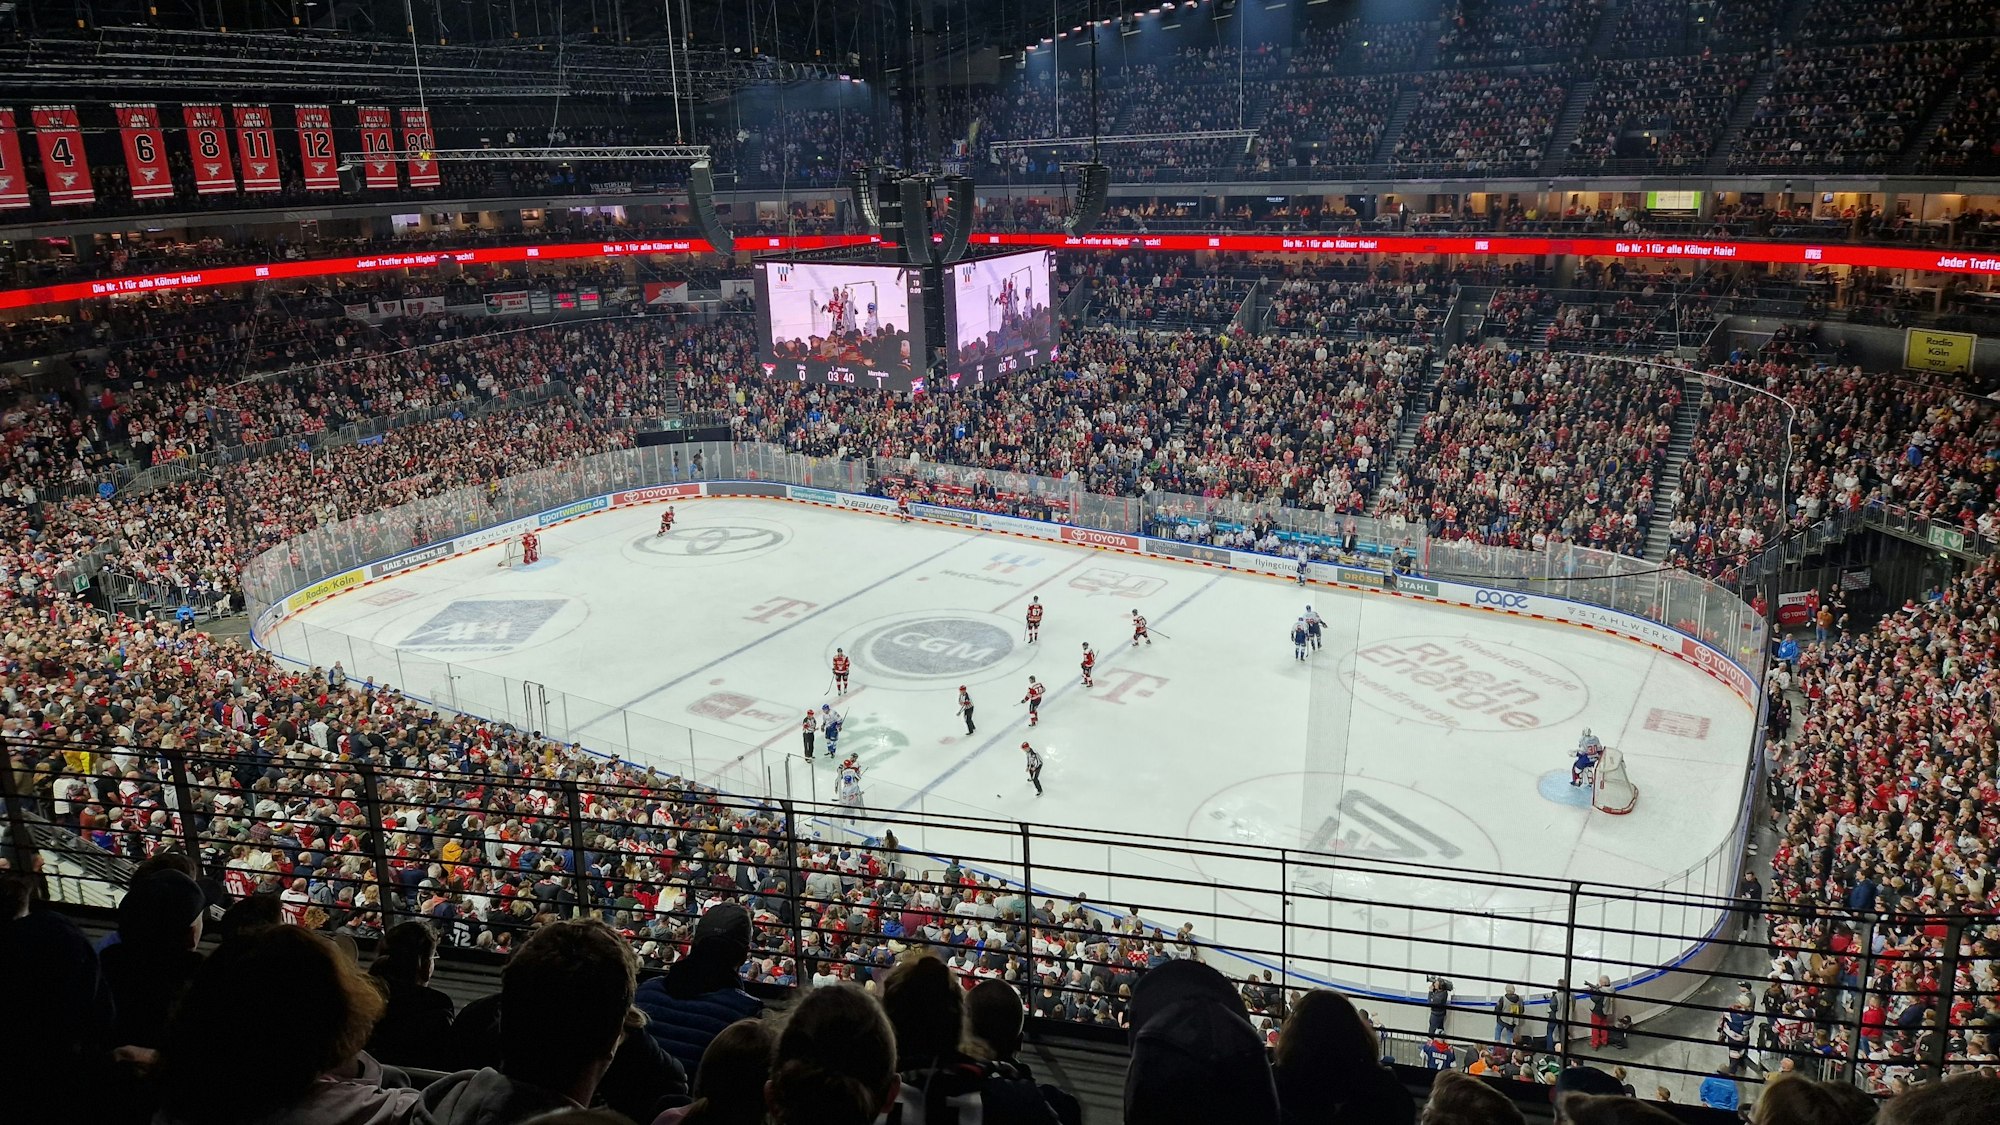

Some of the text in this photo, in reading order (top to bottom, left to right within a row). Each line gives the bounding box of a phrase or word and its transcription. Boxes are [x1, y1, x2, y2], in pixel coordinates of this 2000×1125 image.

[51, 137, 74, 167] 4
[134, 133, 156, 163] 6
[199, 131, 219, 158] 8
[243, 131, 271, 159] 11
[303, 131, 332, 158] 12
[365, 133, 391, 157] 14
[1065, 237, 1081, 245] Jeder
[1082, 237, 1101, 245] Treffer
[1144, 238, 1161, 246] acht!
[1283, 240, 1293, 248] Die
[1295, 240, 1304, 248] Nr.
[1310, 240, 1320, 248] für
[1322, 240, 1334, 248] alle
[1336, 240, 1358, 248] Kölner
[1360, 240, 1377, 249] Haie!
[1616, 243, 1736, 256] Die Nr. 1 für alle Kölner Haie!
[357, 259, 376, 268] Jeder
[378, 258, 401, 266] Treffer
[404, 256, 414, 264] ein
[455, 252, 475, 261] acht!
[1937, 256, 1967, 268] Jeder
[92, 284, 105, 294] Die
[106, 282, 118, 292] Nr.
[124, 280, 136, 290] für
[138, 278, 153, 288] alle
[154, 276, 180, 286] Kölner
[182, 274, 202, 284] Haie!
[1926, 336, 1954, 347] Radio
[1928, 348, 1950, 357] Köln
[800, 370, 806, 381] 0
[876, 377, 882, 388] 1
[640, 487, 680, 499] TOYOTA
[541, 498, 605, 524] sportwetten.de
[468, 522, 530, 545] STAHLWERK
[1088, 532, 1128, 547] TOYOTA
[381, 546, 447, 572] HAIE-TICKETS.DE
[305, 576, 355, 601] Radio Köln
[1475, 590, 1528, 608] pape
[1578, 610, 1670, 642] STAHLWERK
[891, 631, 997, 662] CGM
[1404, 642, 1540, 706] Rhein
[1455, 639, 1579, 691] RheinEnergie
[1712, 656, 1746, 688] TOYOTA
[1357, 644, 1540, 728] Energie
[1342, 670, 1461, 728] RheinEnergie
[453, 928, 471, 947] 72
